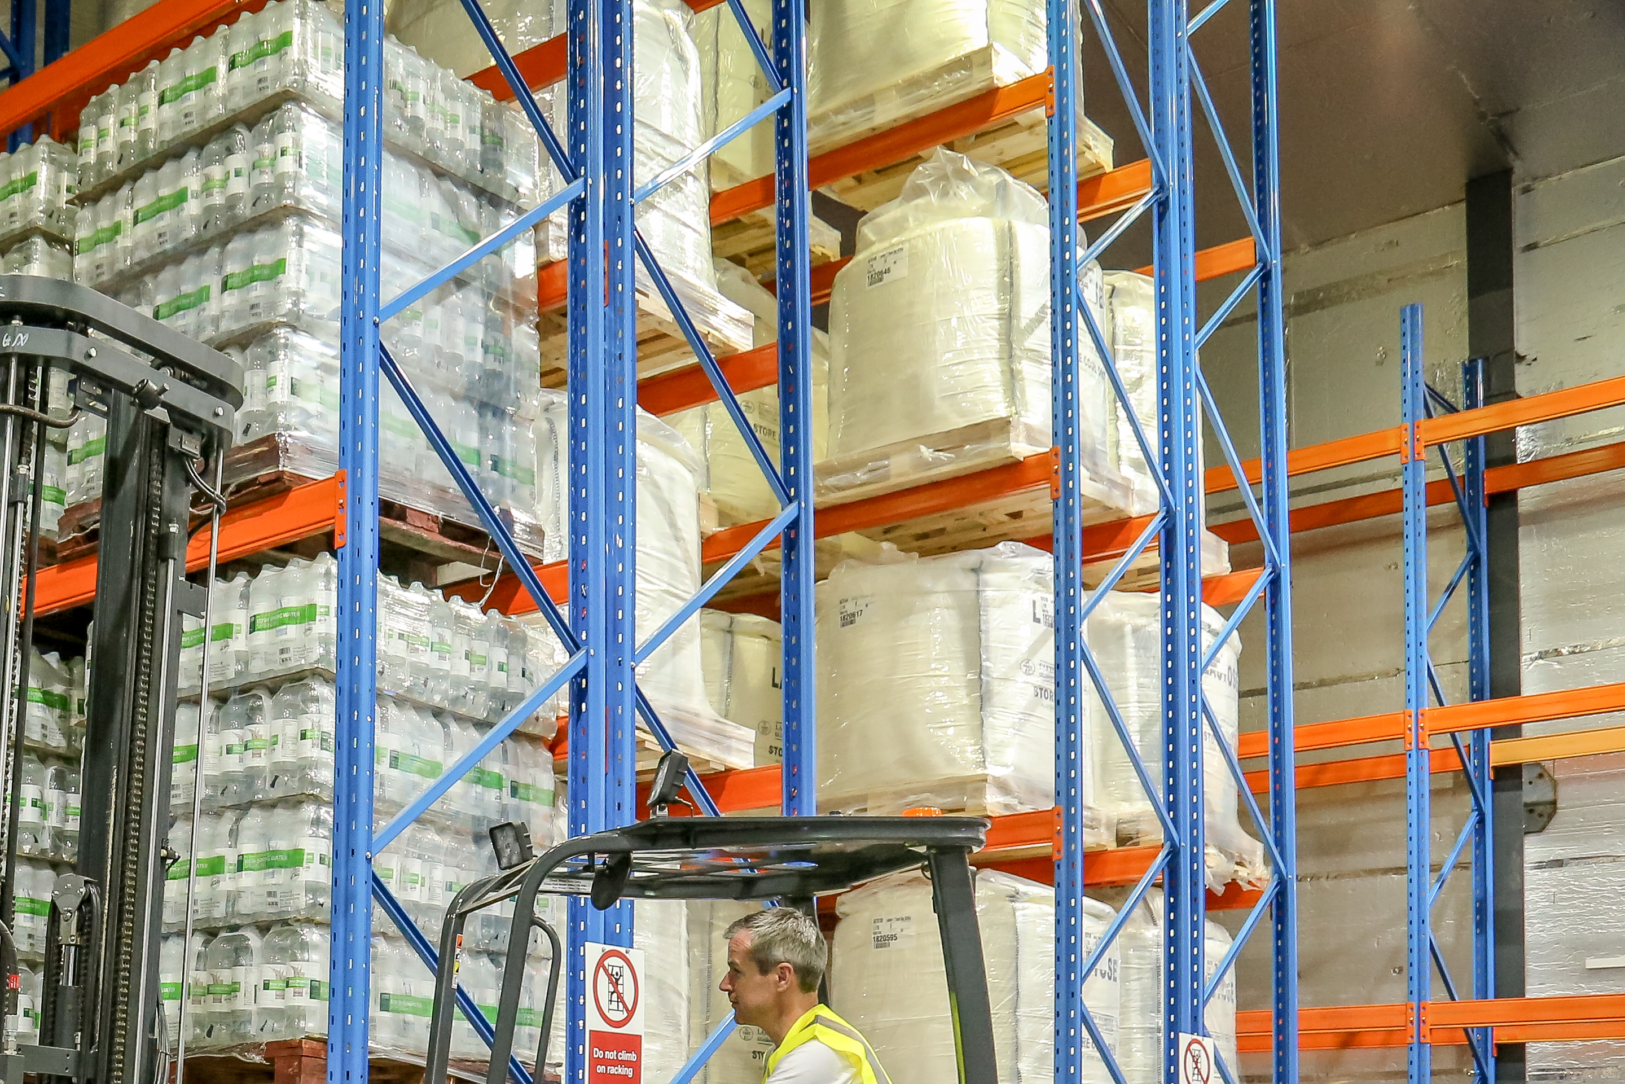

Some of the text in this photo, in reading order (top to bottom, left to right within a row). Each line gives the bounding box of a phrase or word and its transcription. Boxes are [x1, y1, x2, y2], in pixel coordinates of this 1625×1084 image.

[1033, 685, 1054, 702] STOR
[593, 1048, 638, 1062] Do not climb
[596, 1065, 634, 1078] on racking
